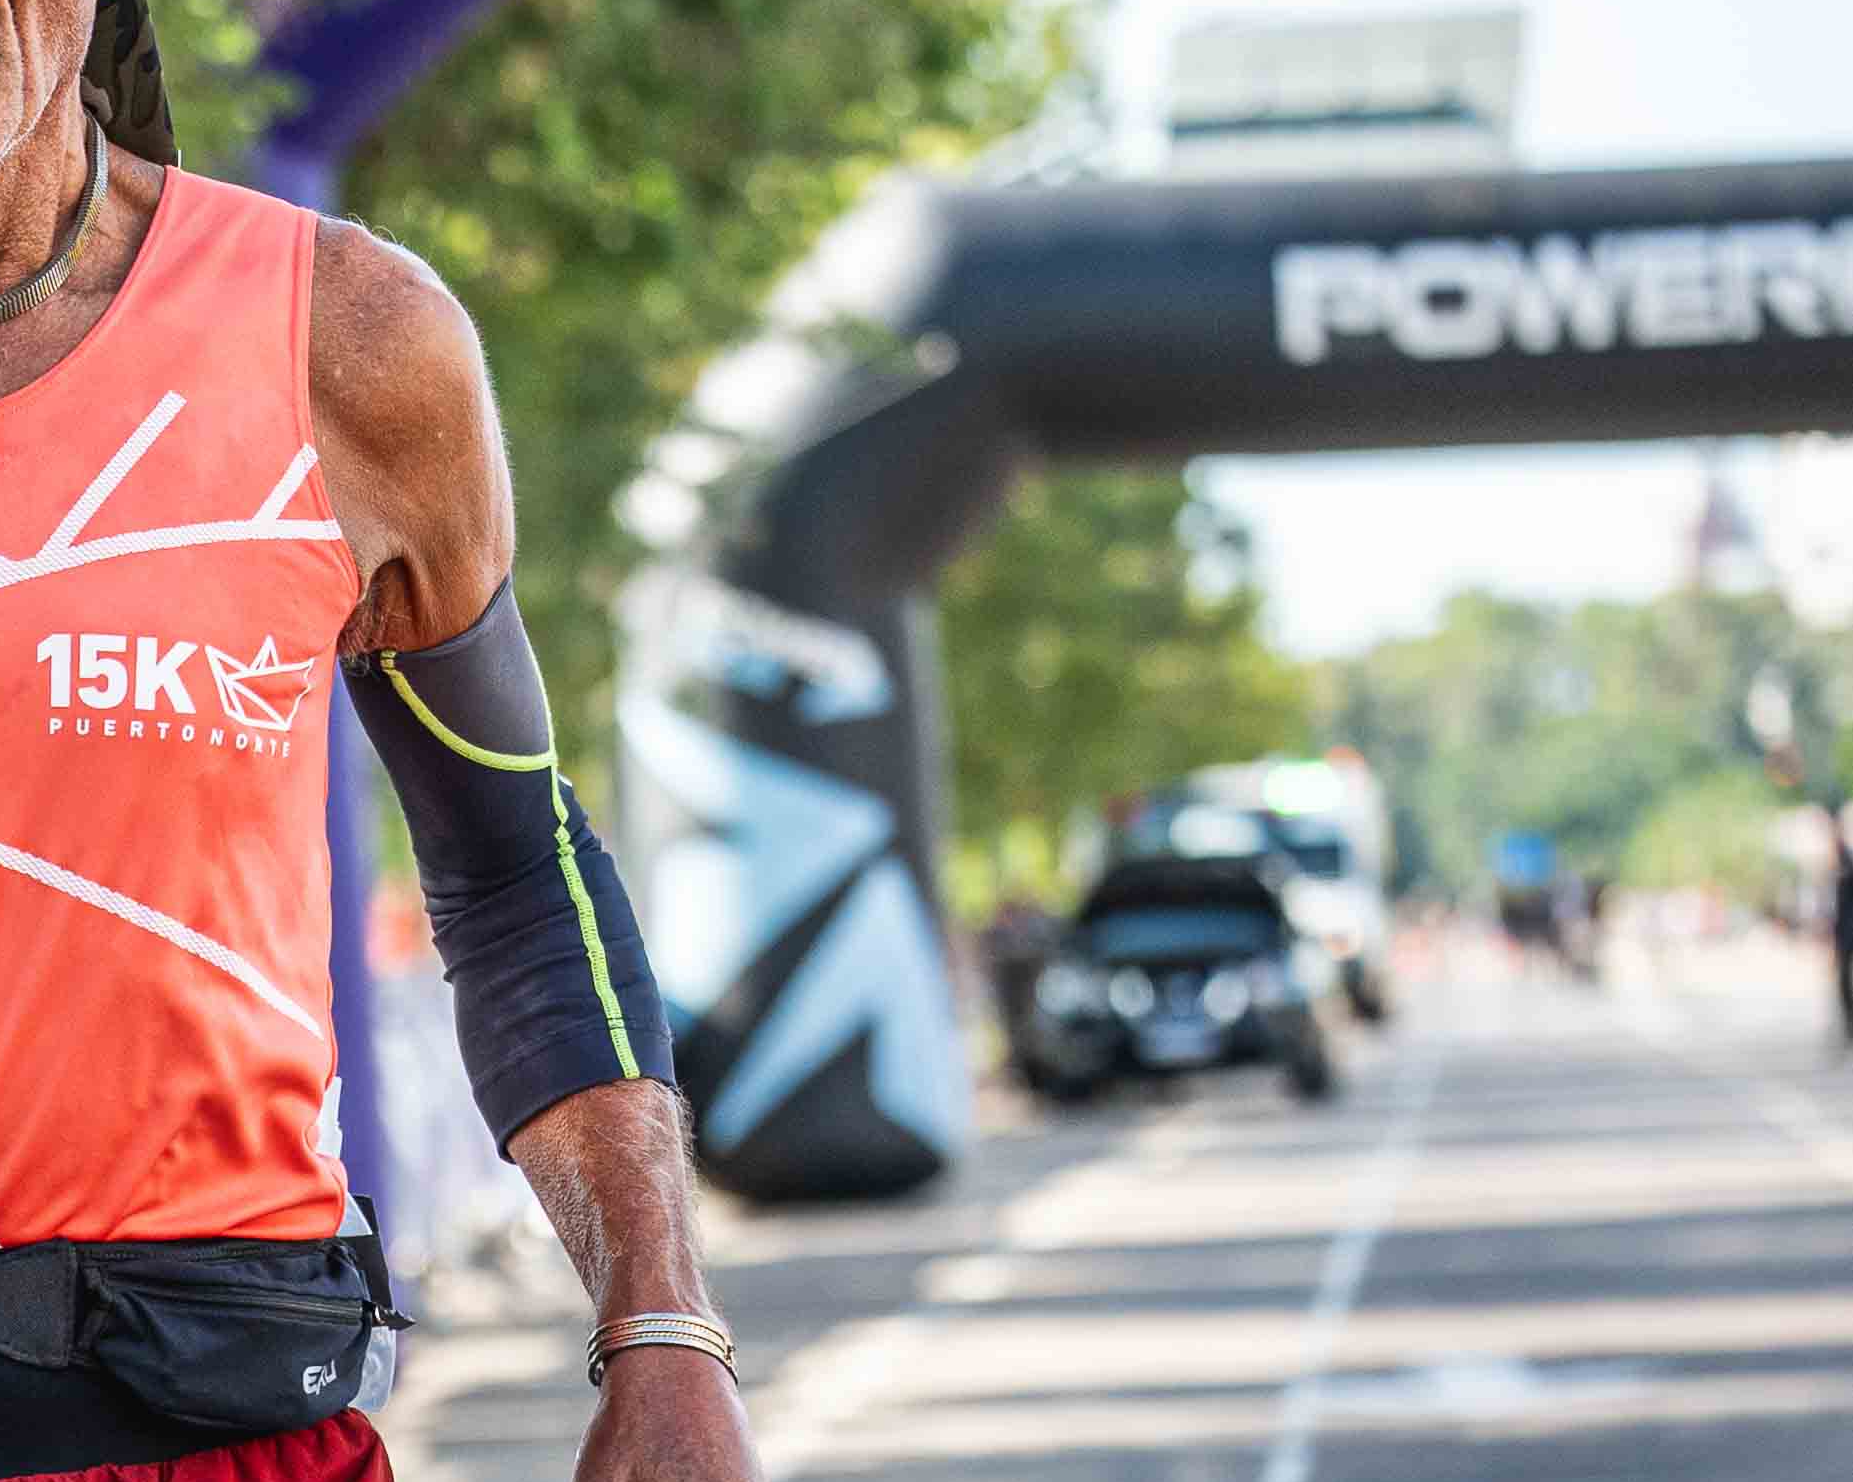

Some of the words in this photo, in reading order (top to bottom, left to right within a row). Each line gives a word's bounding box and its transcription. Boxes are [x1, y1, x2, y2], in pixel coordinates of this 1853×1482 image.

[1272, 215, 1853, 366] POWER
[36, 632, 199, 715] 15K
[48, 717, 196, 742] PUERTO
[209, 728, 292, 758] NORTE
